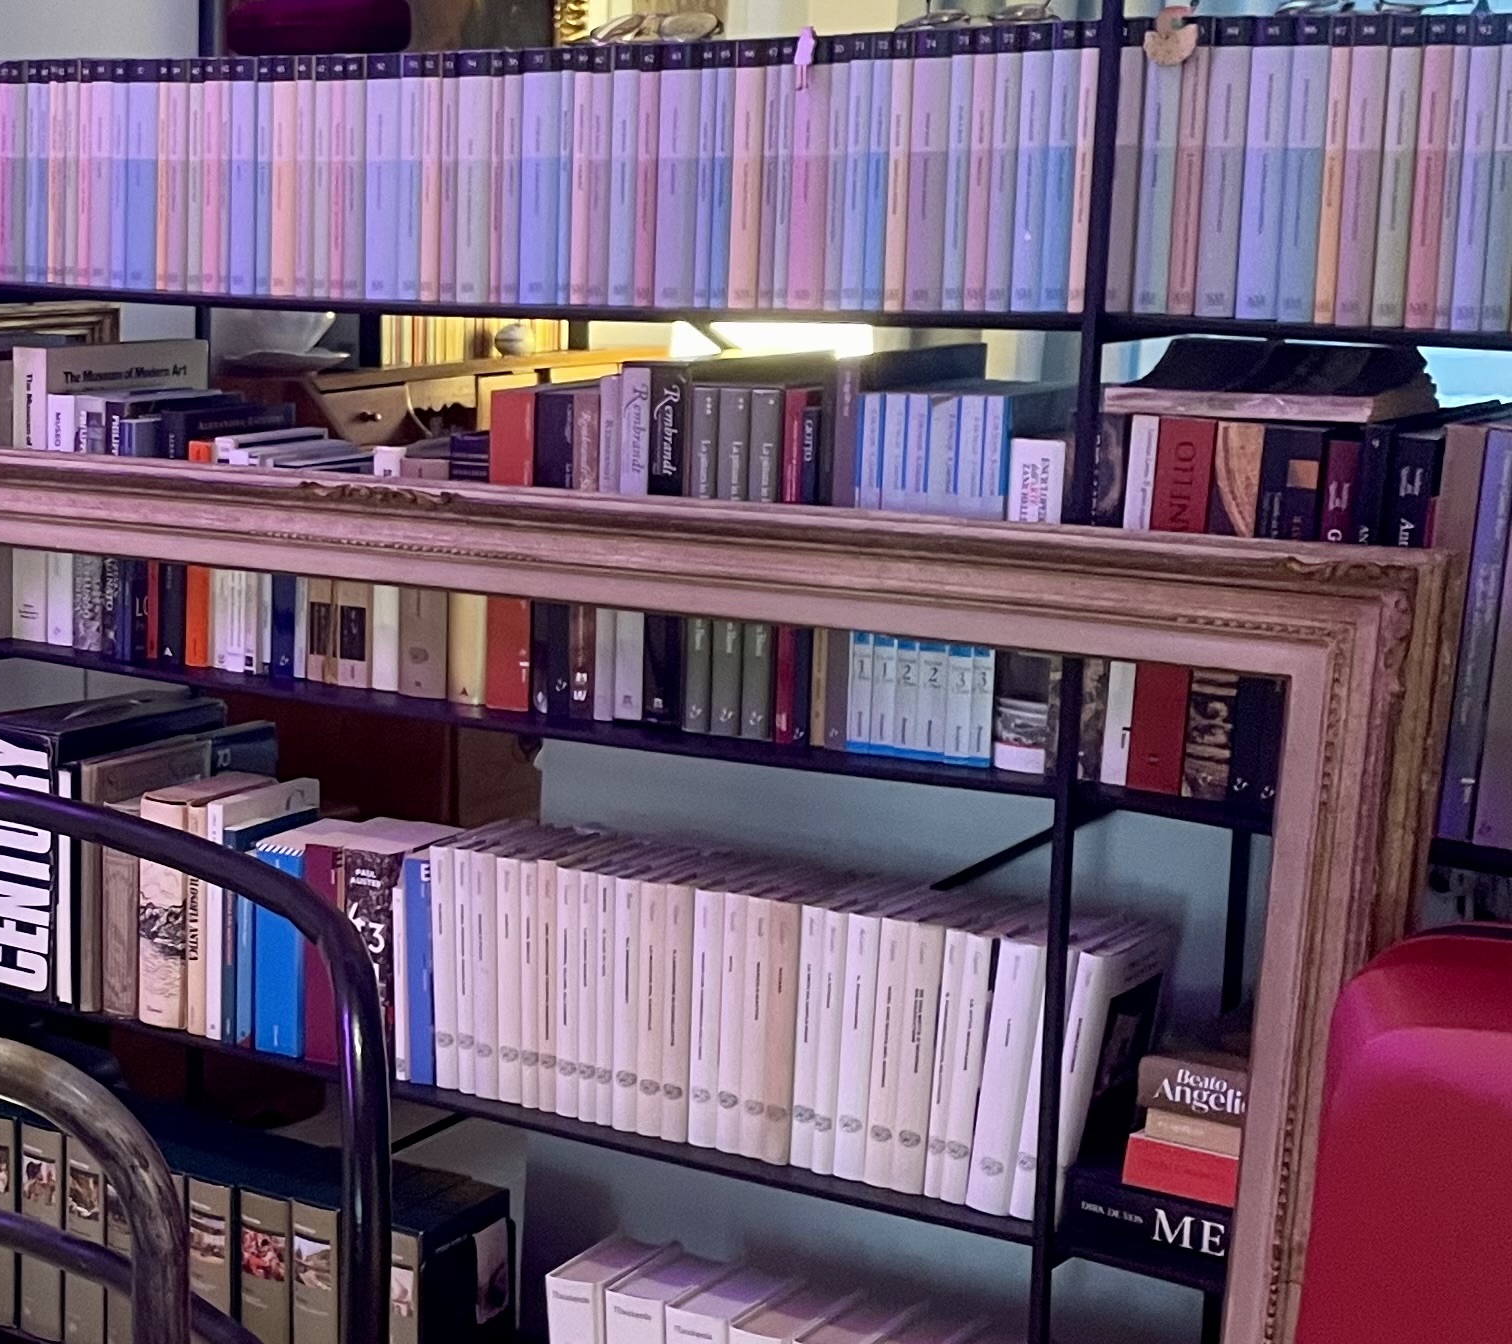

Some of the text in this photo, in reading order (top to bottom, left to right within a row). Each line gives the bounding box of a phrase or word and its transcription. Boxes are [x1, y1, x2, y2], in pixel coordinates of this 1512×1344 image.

[64, 370, 81, 384] The
[82, 369, 124, 383] Museum
[172, 363, 188, 377] Art
[623, 383, 649, 474] Rembrandt
[653, 384, 681, 476] Rembrandt
[804, 419, 814, 463] GIOTTO
[354, 868, 377, 879] PAUL
[1176, 1068, 1228, 1093] Beato
[1151, 1207, 1226, 1257] ME
